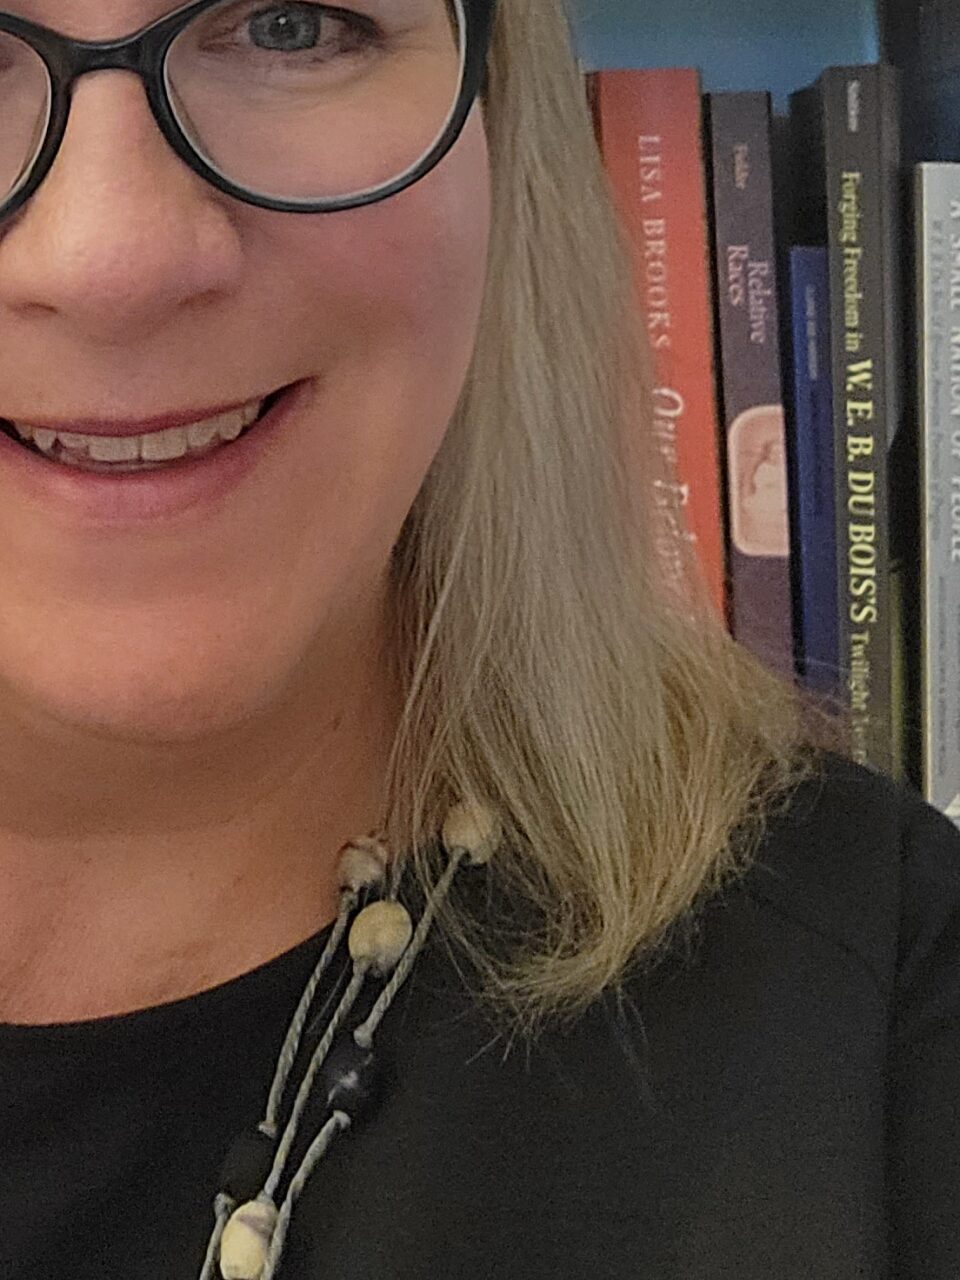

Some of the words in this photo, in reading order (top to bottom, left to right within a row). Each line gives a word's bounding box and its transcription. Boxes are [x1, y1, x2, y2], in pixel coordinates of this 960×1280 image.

[638, 134, 663, 203] LISA
[838, 171, 862, 243] Forging
[641, 218, 673, 349] BROOKS
[726, 244, 749, 307] Races
[747, 260, 773, 344] Relative
[843, 246, 862, 327] Freedom
[845, 331, 863, 352] in
[845, 359, 874, 392] W.
[846, 400, 874, 427] E.
[847, 434, 875, 462] B.
[848, 471, 876, 516] DU
[848, 523, 878, 623] BOIS'S
[848, 631, 870, 710] Twilight
